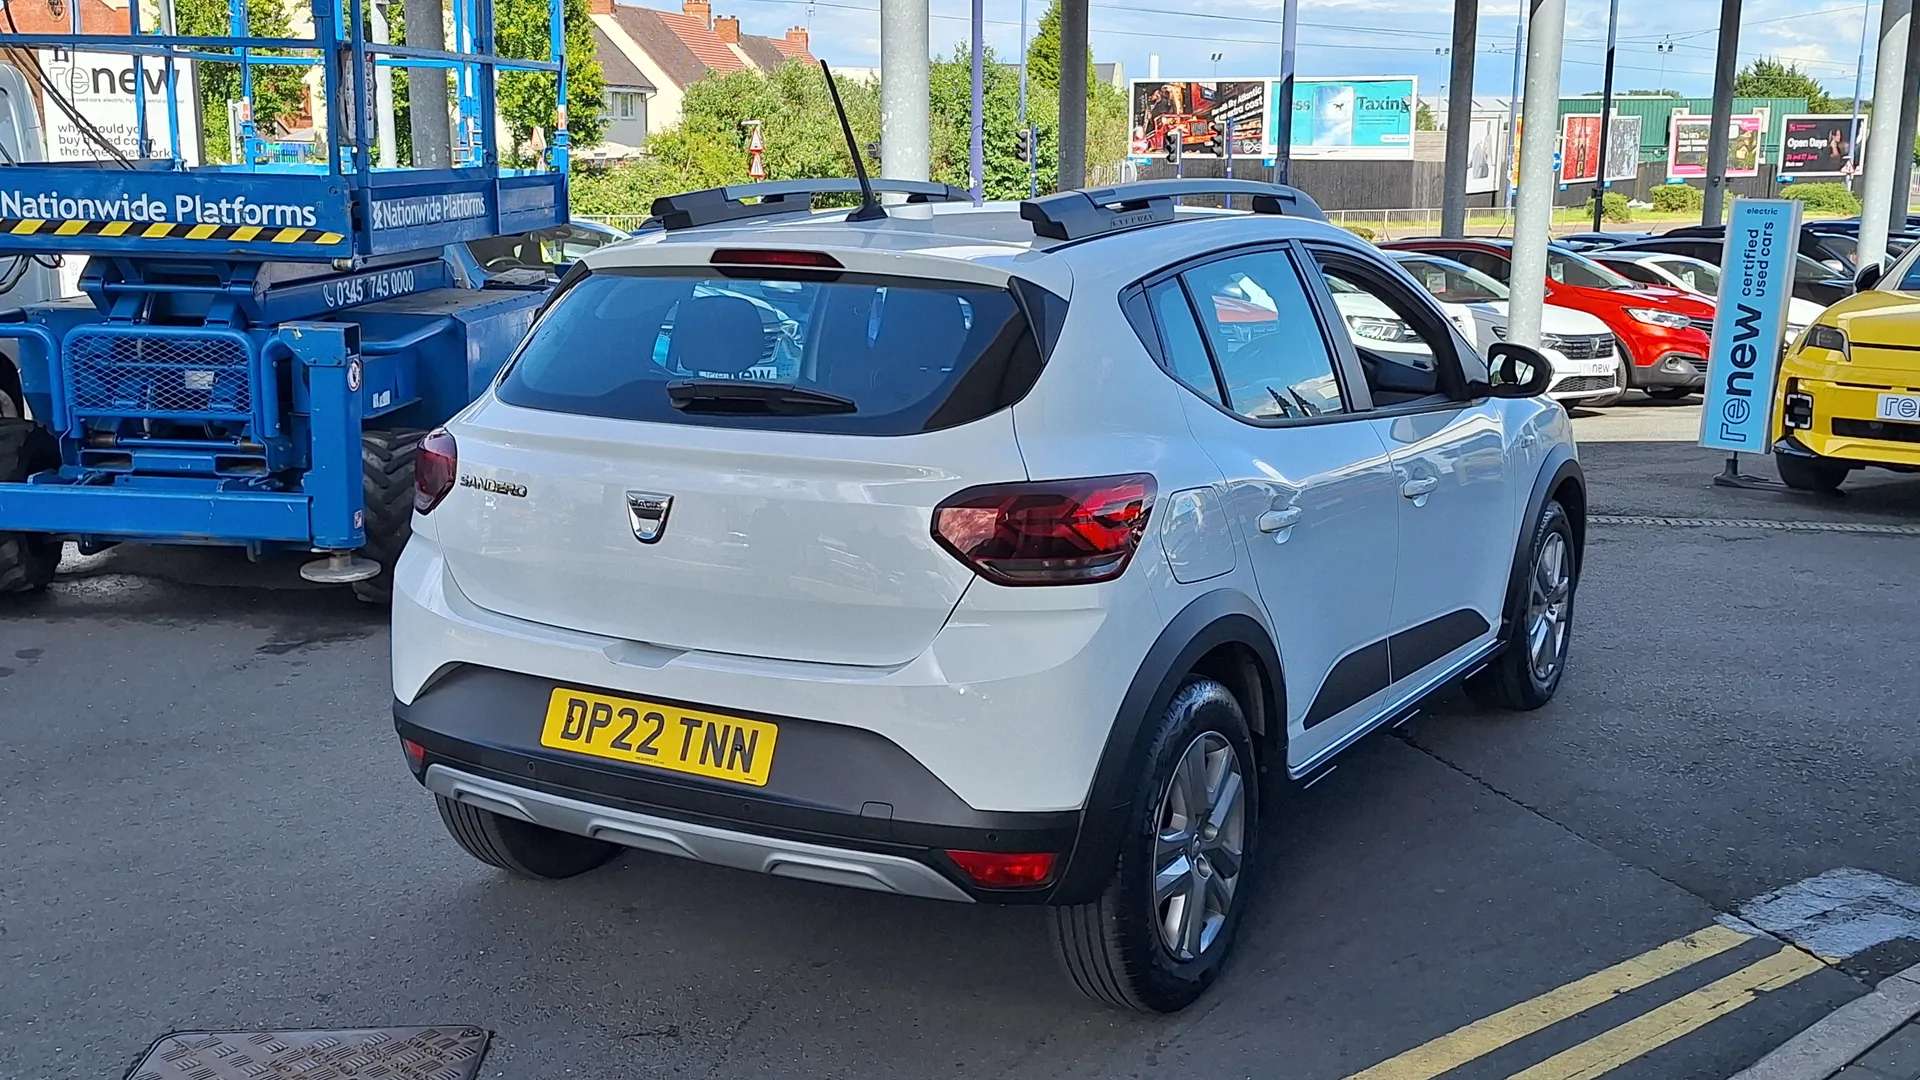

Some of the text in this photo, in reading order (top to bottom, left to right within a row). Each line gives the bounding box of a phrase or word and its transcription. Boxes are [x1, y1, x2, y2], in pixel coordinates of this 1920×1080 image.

[1245, 95, 1263, 111] cost
[1356, 95, 1410, 113] Taxing
[59, 135, 80, 146] buy
[1787, 137, 1828, 150] Open Days
[60, 147, 79, 157] the
[120, 148, 170, 158] netork
[0, 190, 318, 226] Nationwide Platforms
[383, 192, 486, 228] Nationwide Platforms
[1746, 207, 1778, 215] electric
[1742, 229, 1759, 297] certified
[1756, 221, 1775, 297] used cars
[336, 269, 415, 306] 0345 745 0000
[1720, 303, 1762, 442] renew
[1885, 397, 1920, 418] re
[460, 475, 528, 498] SANDERO
[560, 697, 759, 774] DP22 TNN
